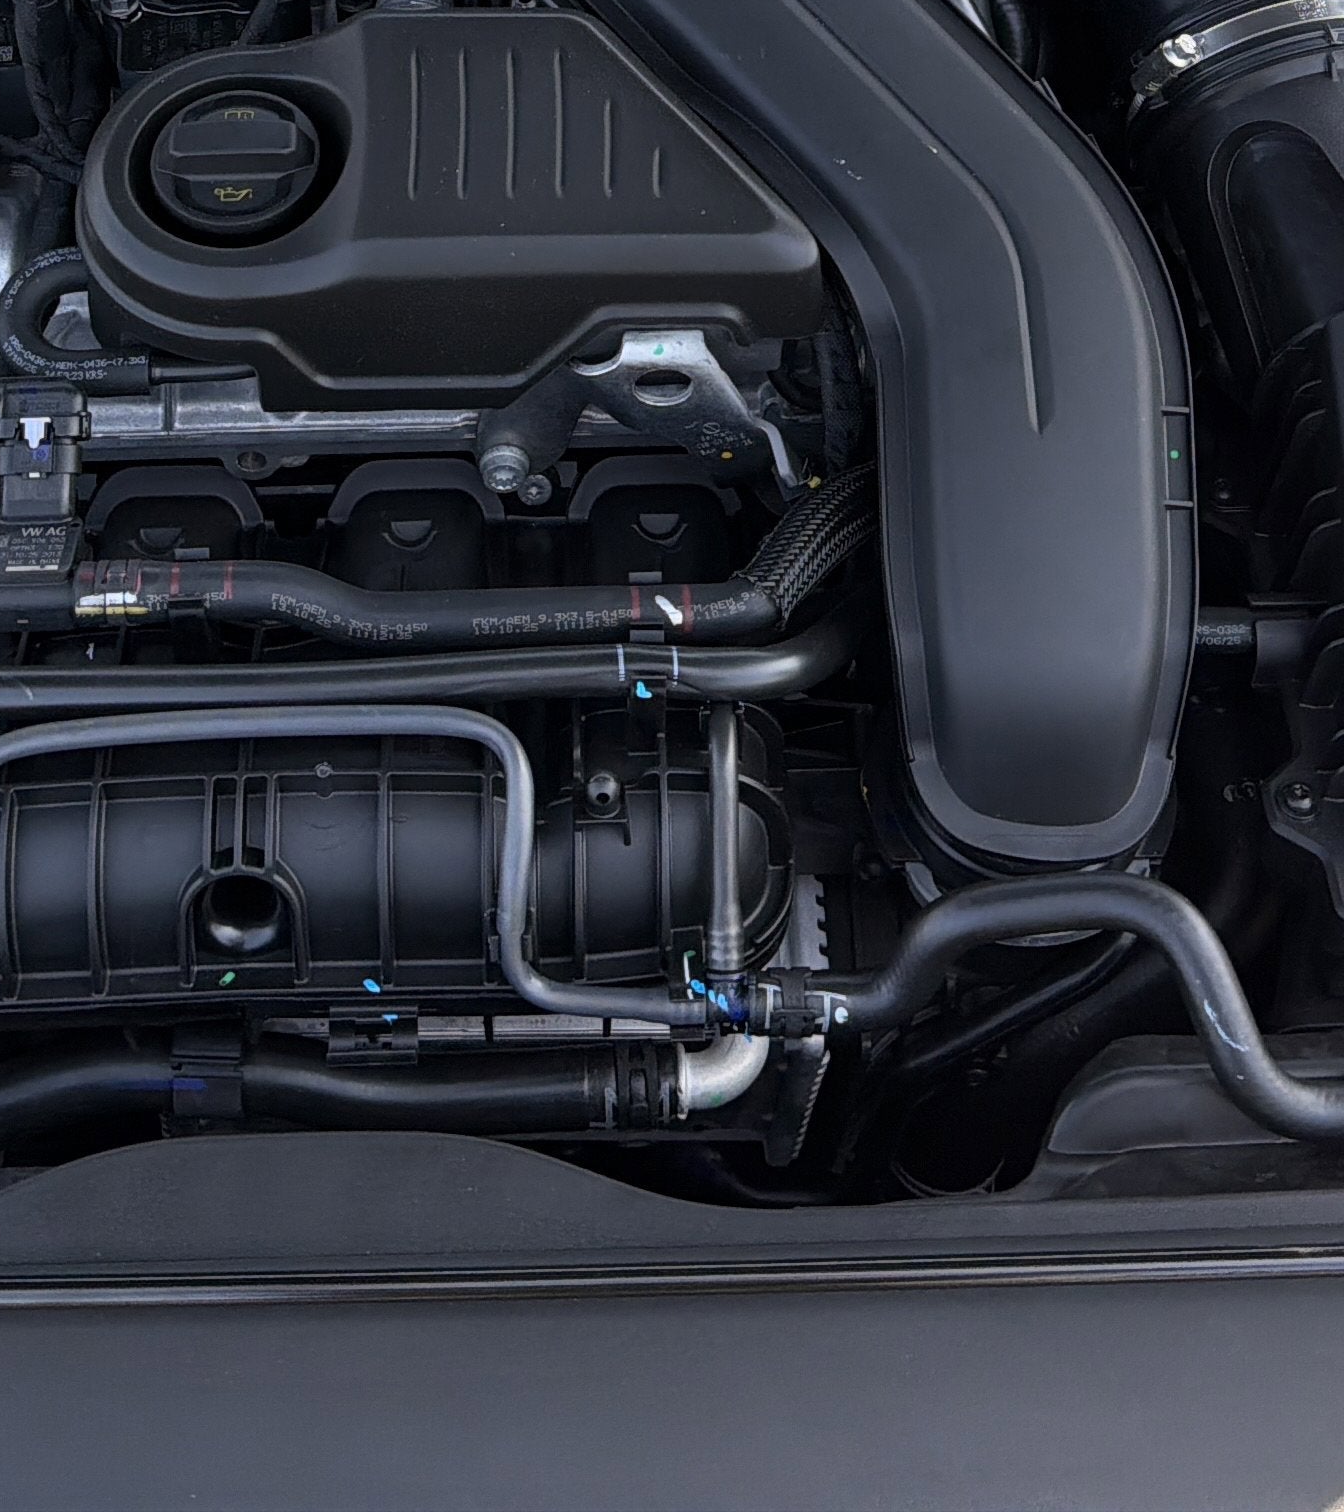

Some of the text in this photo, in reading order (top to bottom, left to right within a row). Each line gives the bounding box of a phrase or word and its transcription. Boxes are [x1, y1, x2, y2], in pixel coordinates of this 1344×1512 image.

[21, 527, 66, 537] VW AG
[271, 592, 327, 618] FKM/AEM
[472, 614, 532, 628] FKM/AEM
